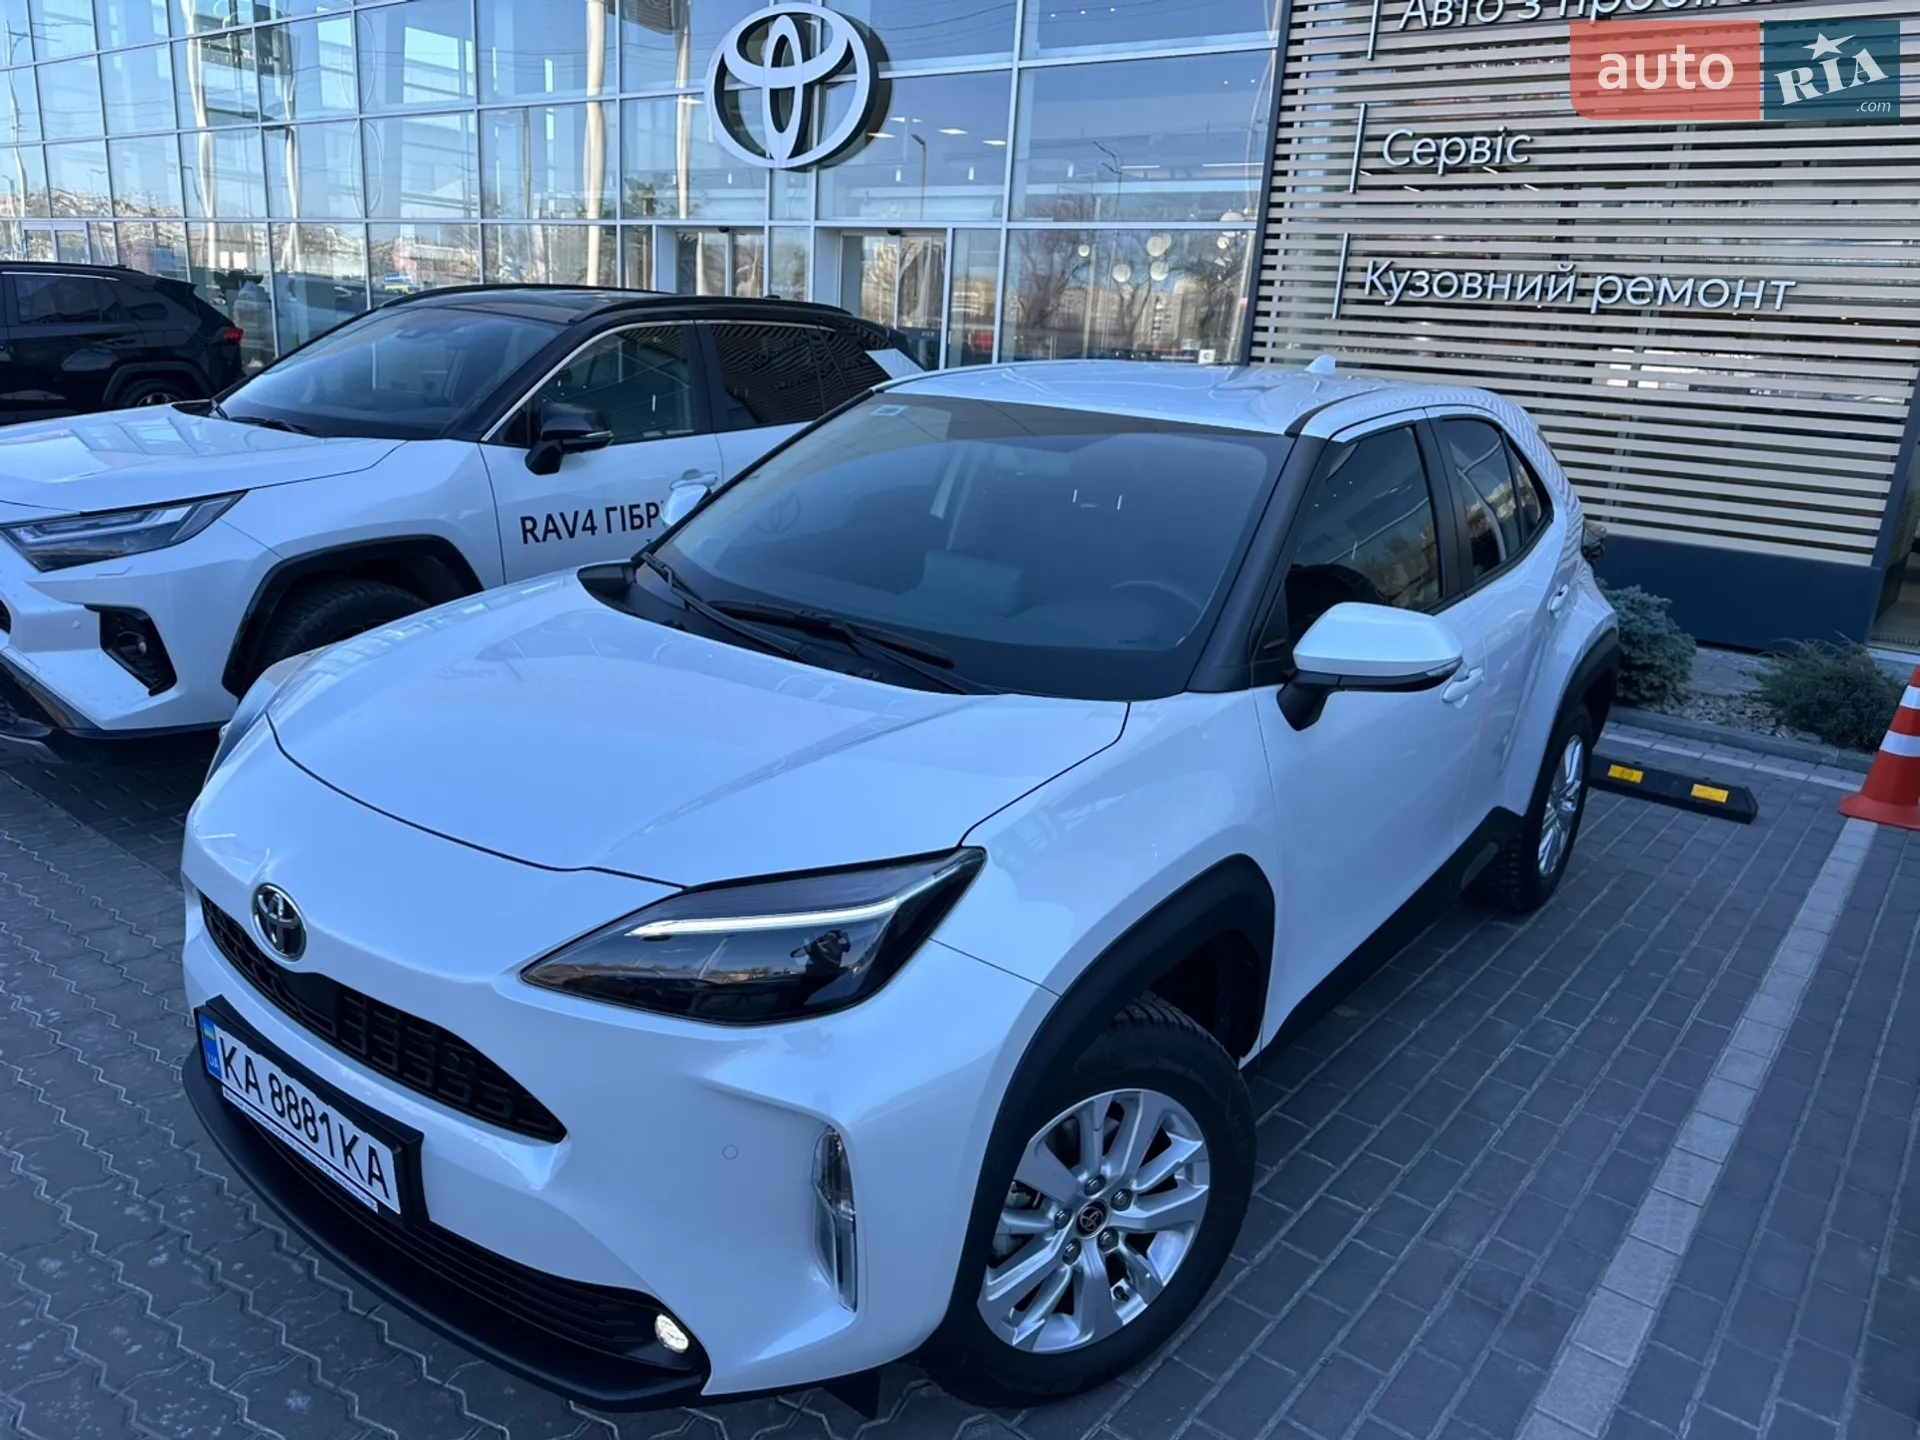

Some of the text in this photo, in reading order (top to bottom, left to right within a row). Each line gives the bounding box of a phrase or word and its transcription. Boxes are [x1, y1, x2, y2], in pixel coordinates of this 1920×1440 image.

[1383, 125, 1532, 176] Сервіс
[1363, 260, 1798, 314] Кузовний ремонт
[520, 501, 663, 544] RAV4 ГІБР
